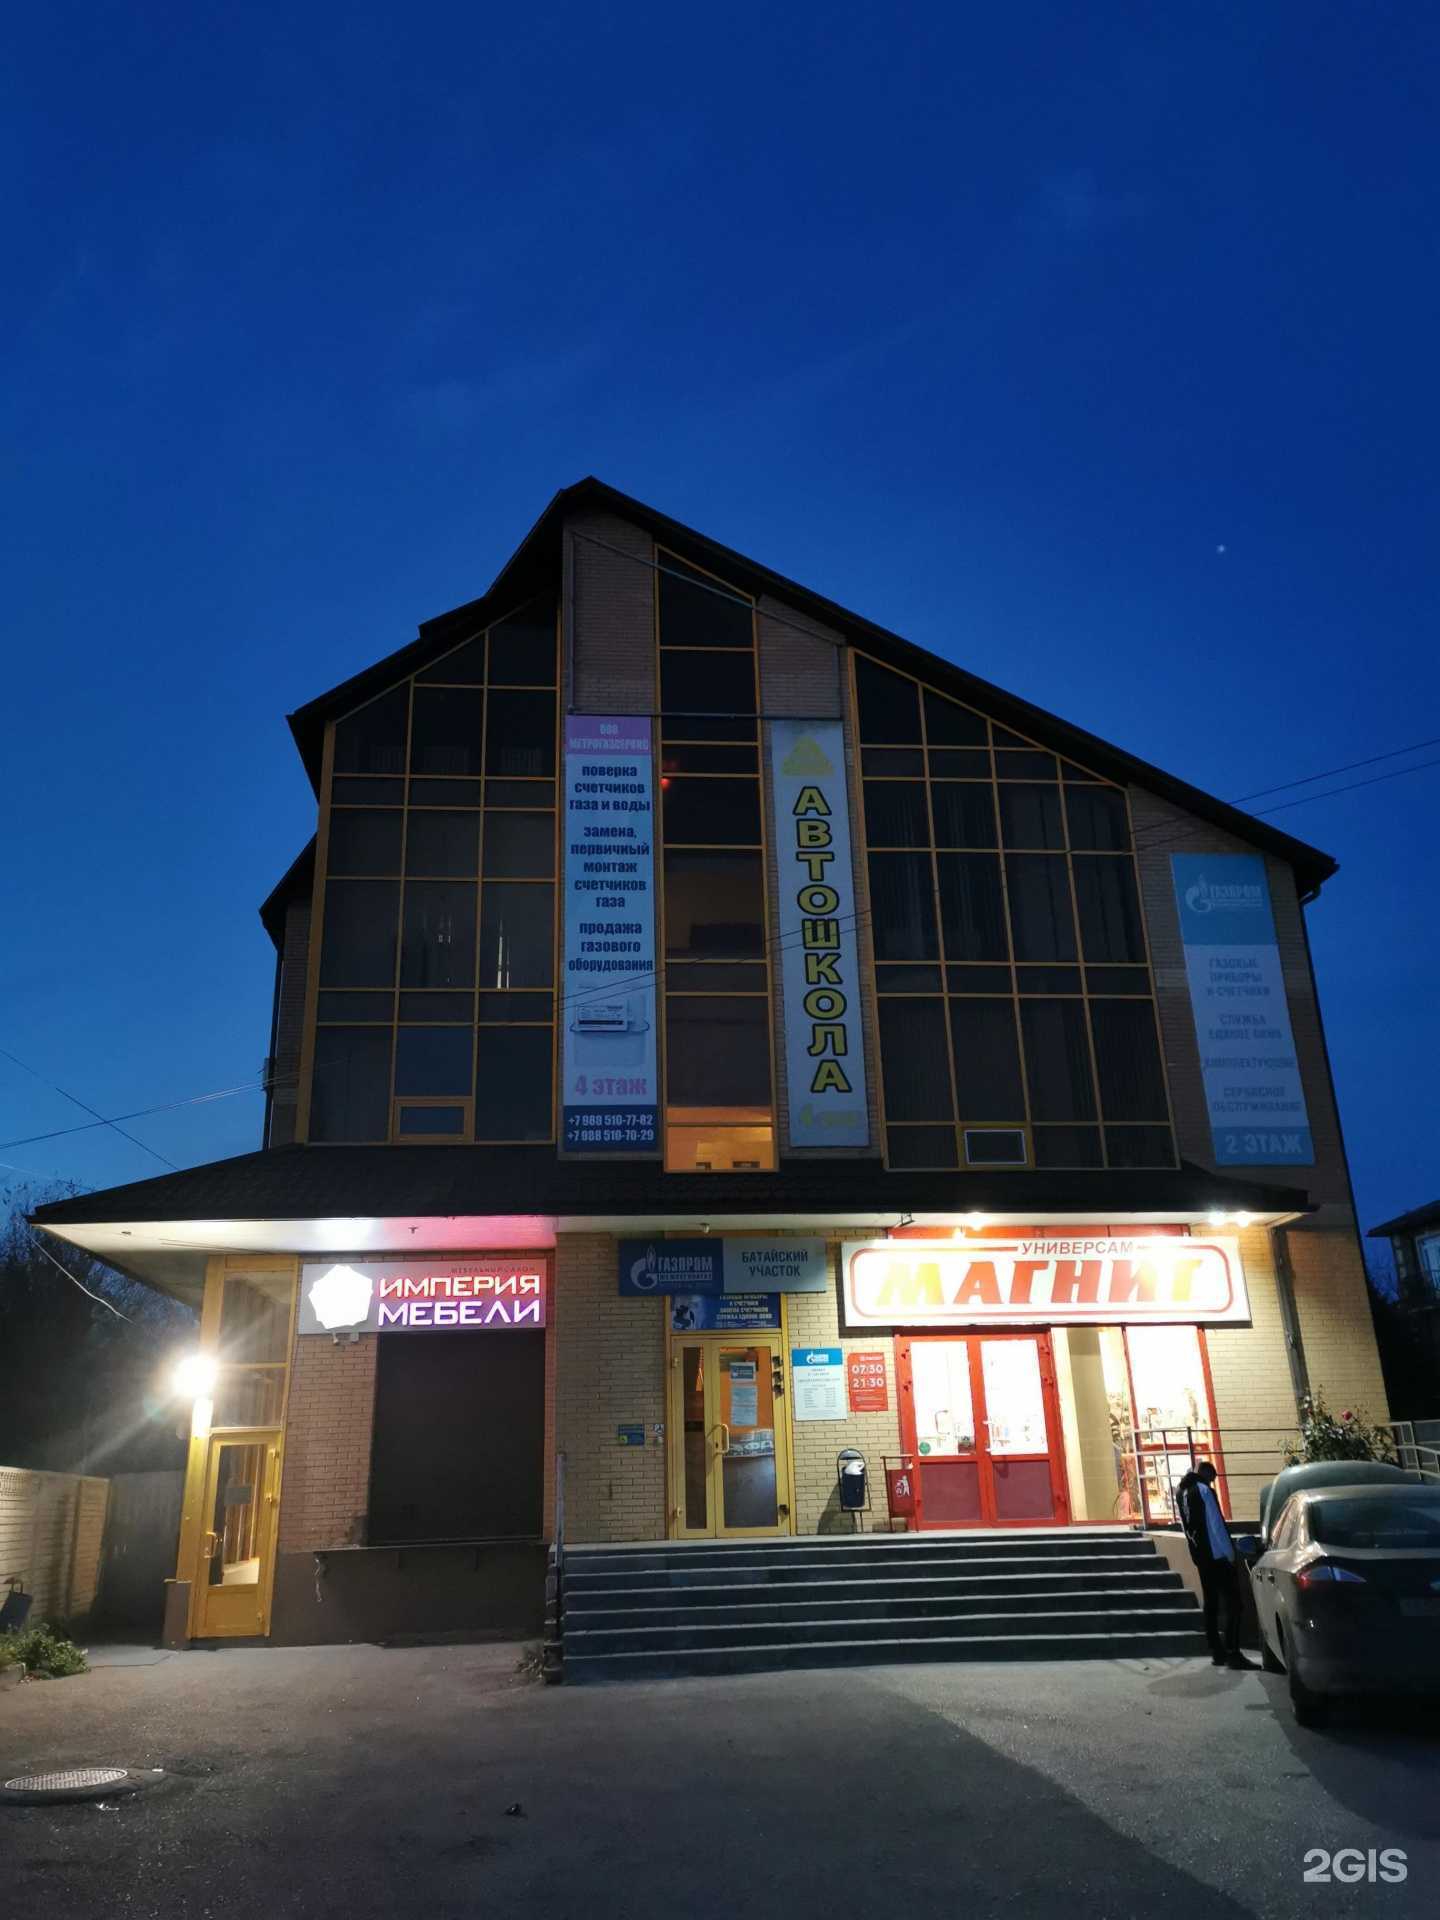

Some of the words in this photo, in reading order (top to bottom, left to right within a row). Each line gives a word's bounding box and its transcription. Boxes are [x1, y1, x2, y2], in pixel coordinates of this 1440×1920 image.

[581, 766, 637, 778] поверка
[574, 783, 646, 794] счетчиков
[569, 800, 598, 810] газа
[601, 801, 610, 810] и
[613, 800, 650, 812] воды
[583, 826, 637, 839] замена,
[570, 843, 650, 856] первичный
[583, 862, 638, 873] монтаж
[574, 880, 647, 891] счетчиков
[595, 897, 626, 908] газа
[579, 923, 642, 936] продажа
[792, 786, 853, 1093] АВТОШКОЛА
[581, 941, 641, 952] газового
[568, 958, 653, 972] оборудования
[575, 1074, 588, 1095] 4
[592, 1077, 647, 1096] этаж
[568, 1115, 580, 1127] +7
[567, 1130, 580, 1142] +7
[1224, 1135, 1238, 1154] 2
[1242, 1134, 1303, 1154] ЭТАЖ
[1020, 1240, 1134, 1256] УНИВЕРСАМ
[741, 1248, 809, 1264] БАТАЙСКИЙ
[657, 1256, 713, 1271] ГАЗПРОМ
[749, 1264, 801, 1278] УЧАСТОК
[379, 1274, 540, 1298] ИМПЕРИЯ
[874, 1258, 1203, 1305] МАГНИТ
[378, 1299, 540, 1327] МЕБЕЛИ
[851, 1364, 883, 1374] 07:30
[853, 1378, 884, 1388] 21:30
